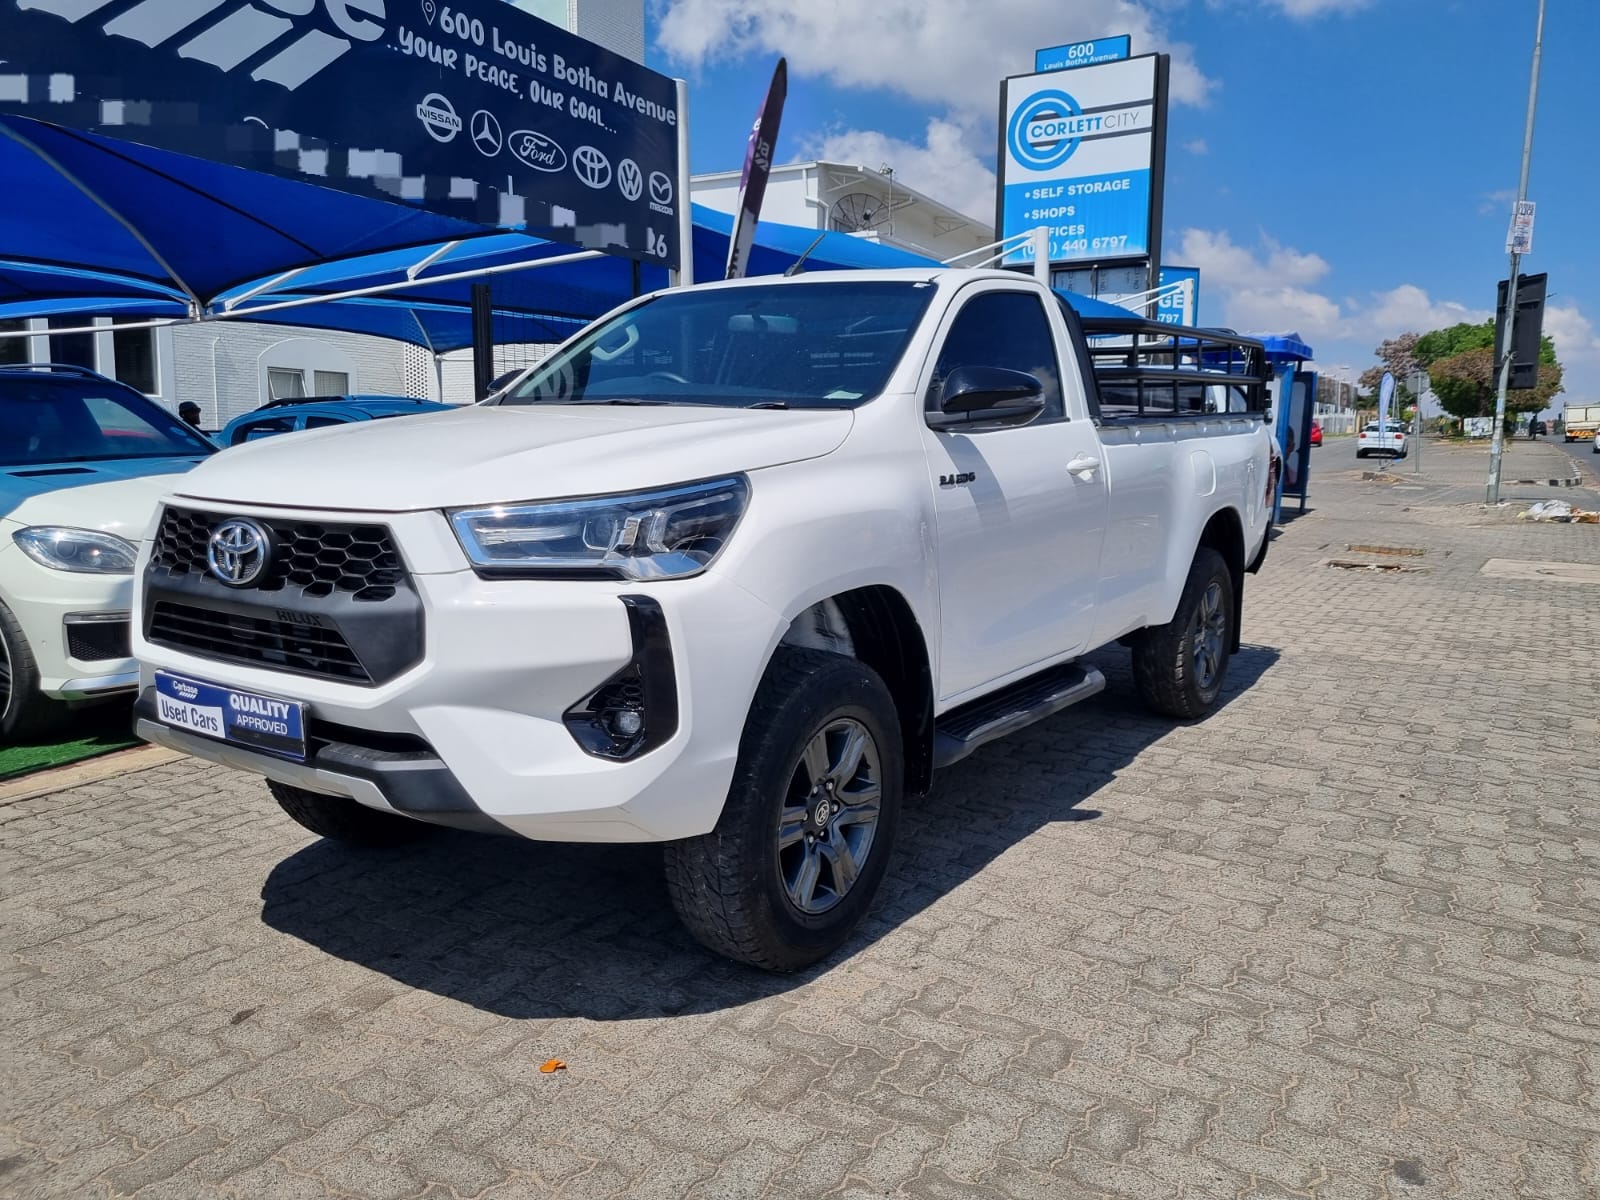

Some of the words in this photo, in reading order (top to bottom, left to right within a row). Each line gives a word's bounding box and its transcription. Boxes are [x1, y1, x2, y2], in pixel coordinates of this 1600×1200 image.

[1068, 43, 1094, 59] 600
[440, 7, 485, 47] 600
[492, 27, 547, 73] Louis
[553, 54, 608, 99] Botha
[613, 82, 677, 126] Avenue
[1043, 61, 1063, 71] Louis
[1065, 57, 1088, 67] Botha
[1089, 53, 1119, 63] Avenue
[530, 81, 564, 112] OUR
[419, 107, 460, 128] NISSAN
[520, 135, 557, 165] Ford
[1032, 186, 1064, 200] SELF
[1068, 179, 1130, 196] STORAGE
[1031, 206, 1075, 220] SHOPS
[1049, 224, 1085, 237] FICES
[1061, 238, 1088, 251] 440
[1092, 235, 1128, 249] 6797
[161, 698, 188, 724] Used
[190, 707, 219, 732] Cars
[230, 693, 290, 719] QUALITY
[236, 714, 288, 735] APPROVED
